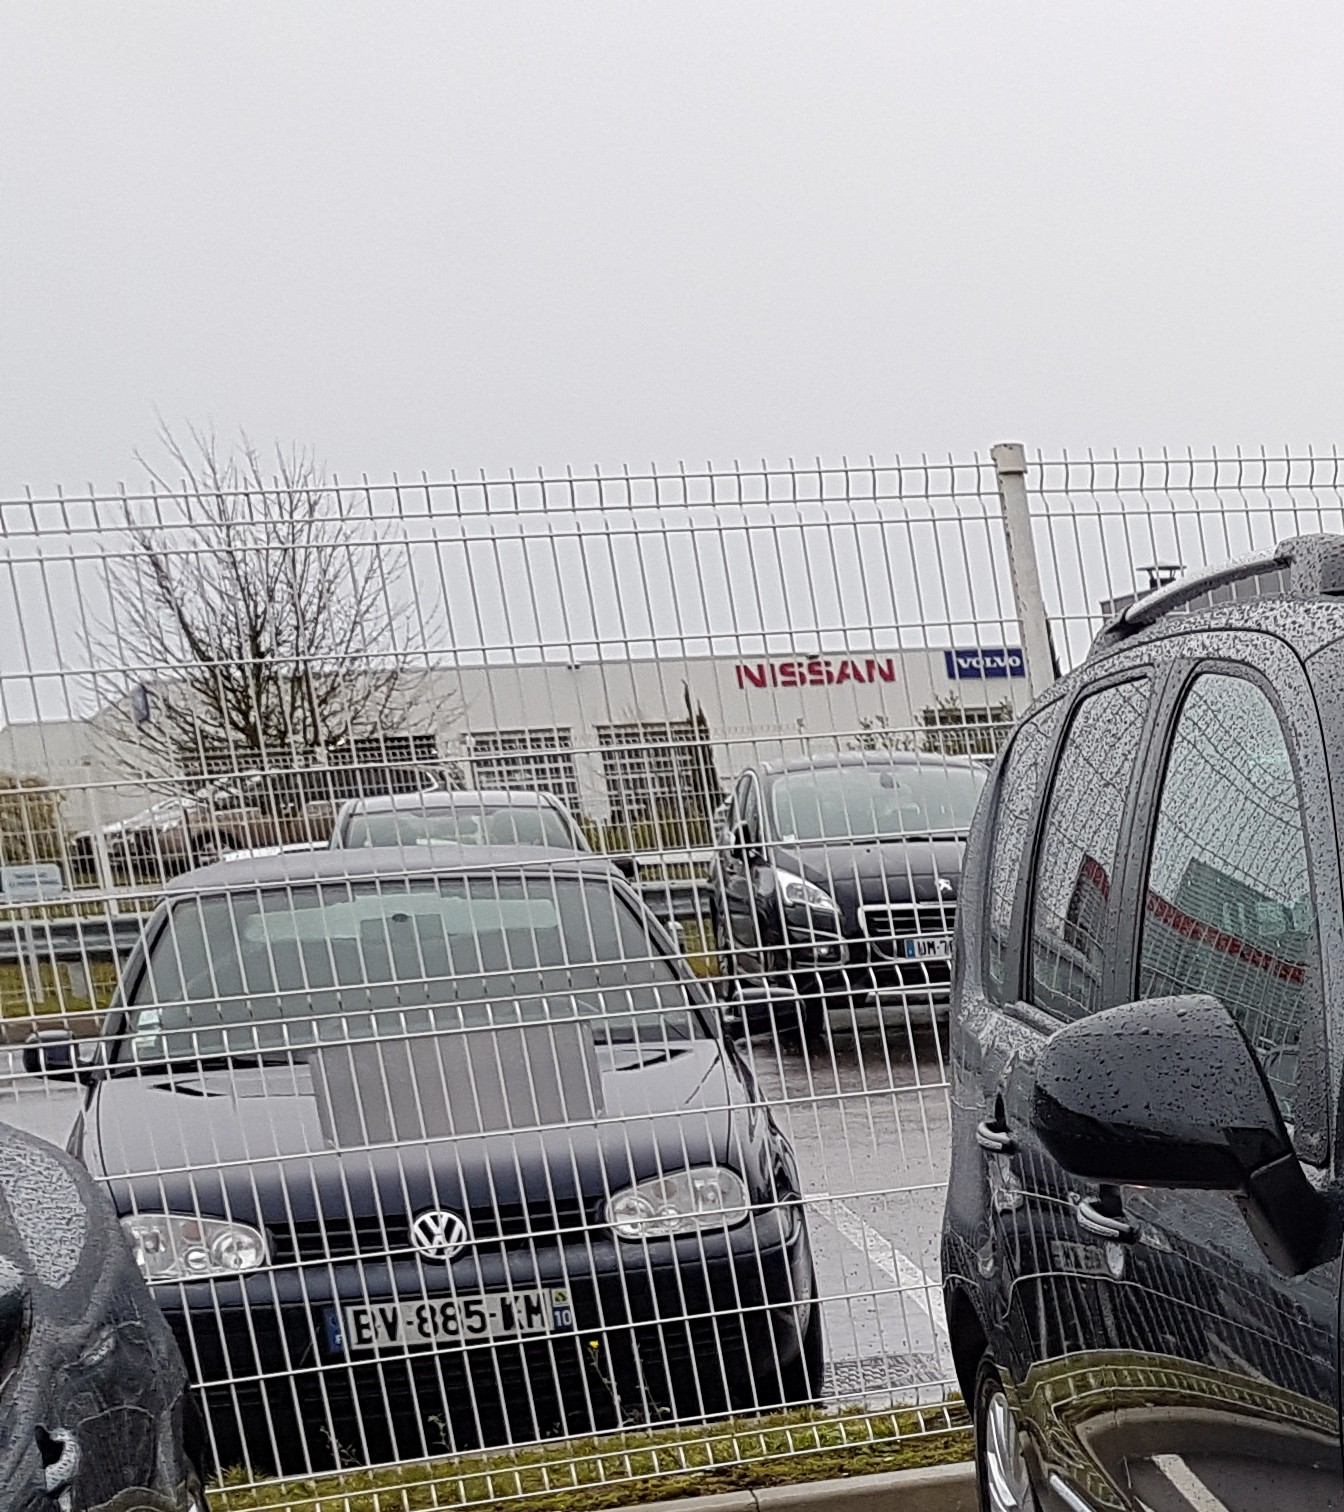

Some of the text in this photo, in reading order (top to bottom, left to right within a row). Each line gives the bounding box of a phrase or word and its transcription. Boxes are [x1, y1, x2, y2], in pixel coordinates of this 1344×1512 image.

[957, 655, 1021, 669] VOLVO
[735, 658, 896, 689] NISSAN
[554, 1309, 572, 1328] 10
